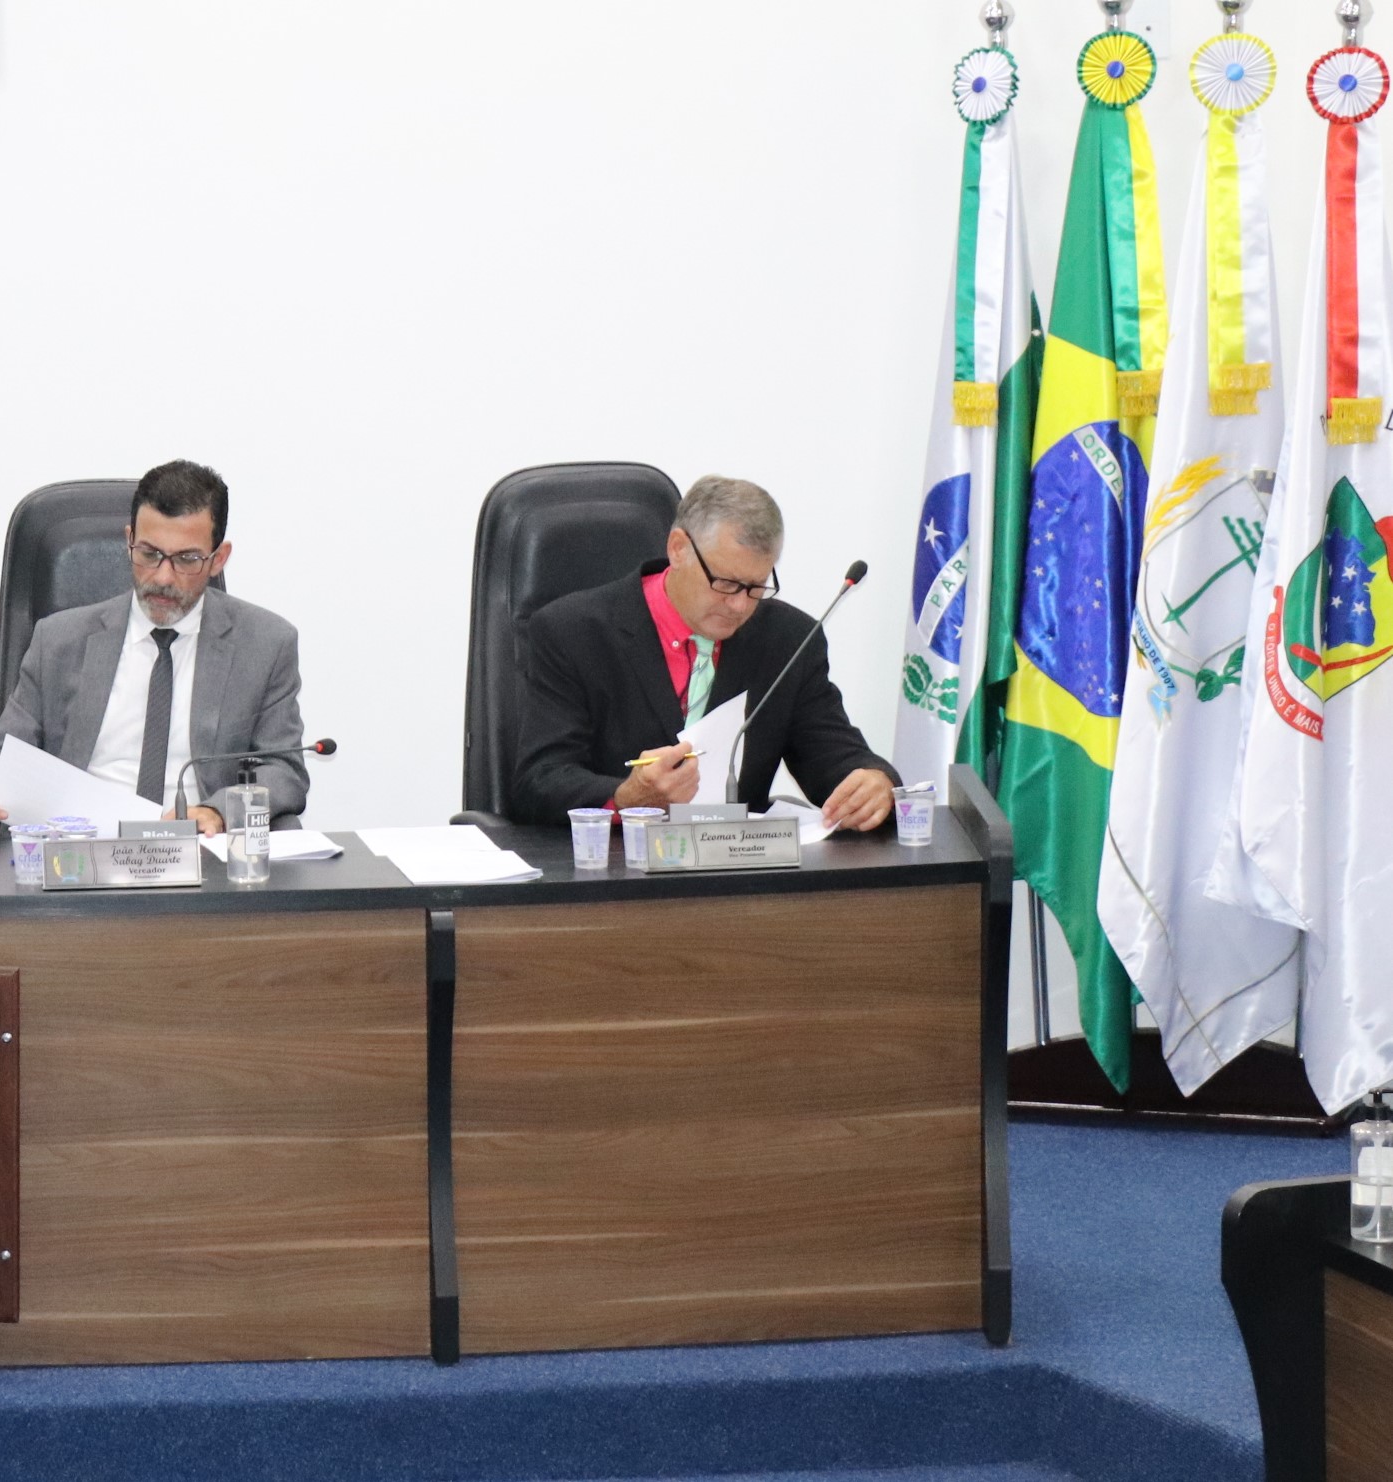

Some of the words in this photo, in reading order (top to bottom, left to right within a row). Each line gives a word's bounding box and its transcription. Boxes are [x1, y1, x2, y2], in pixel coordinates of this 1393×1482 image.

[1157, 666, 1175, 690] 1907
[1293, 711, 1321, 734] MAIS
[111, 845, 134, 857] João
[137, 844, 183, 856] Henrique
[128, 867, 167, 875] Vereador
